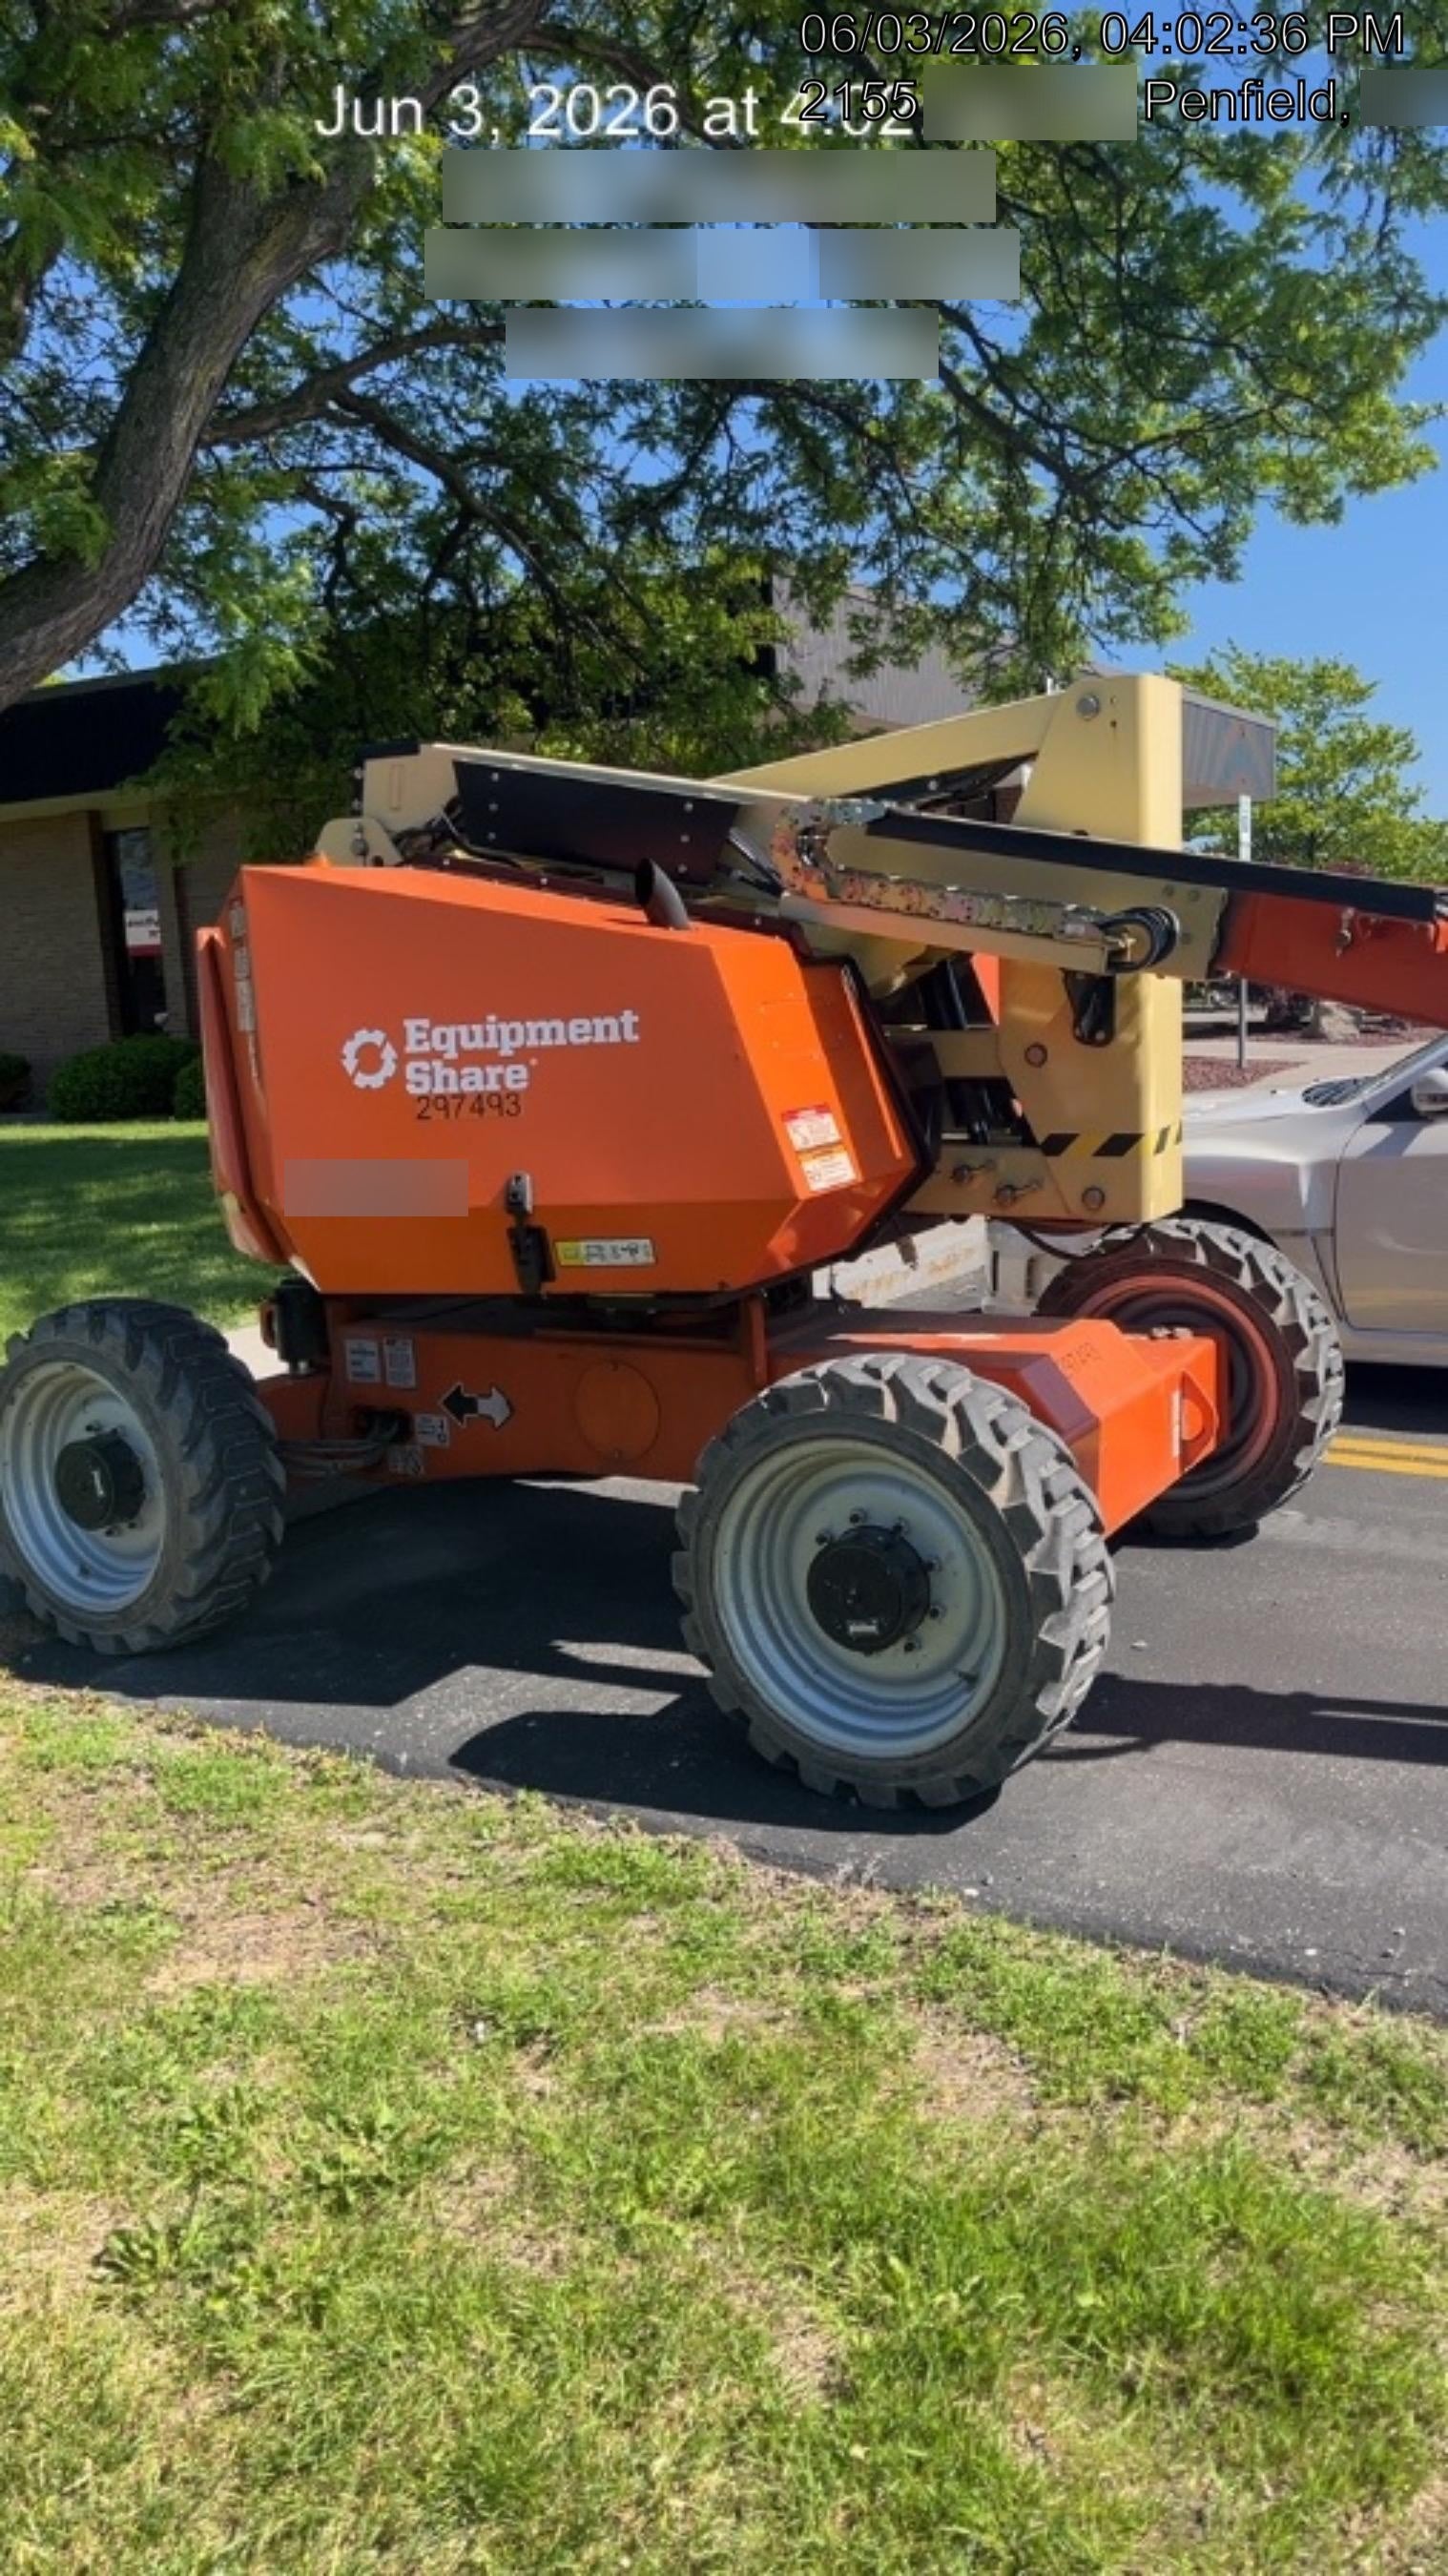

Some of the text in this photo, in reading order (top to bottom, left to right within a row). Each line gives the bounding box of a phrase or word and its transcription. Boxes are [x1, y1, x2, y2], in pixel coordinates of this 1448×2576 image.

[403, 1009, 640, 1059] Equipment
[404, 1059, 529, 1095] Share
[415, 1092, 522, 1121] 297493
